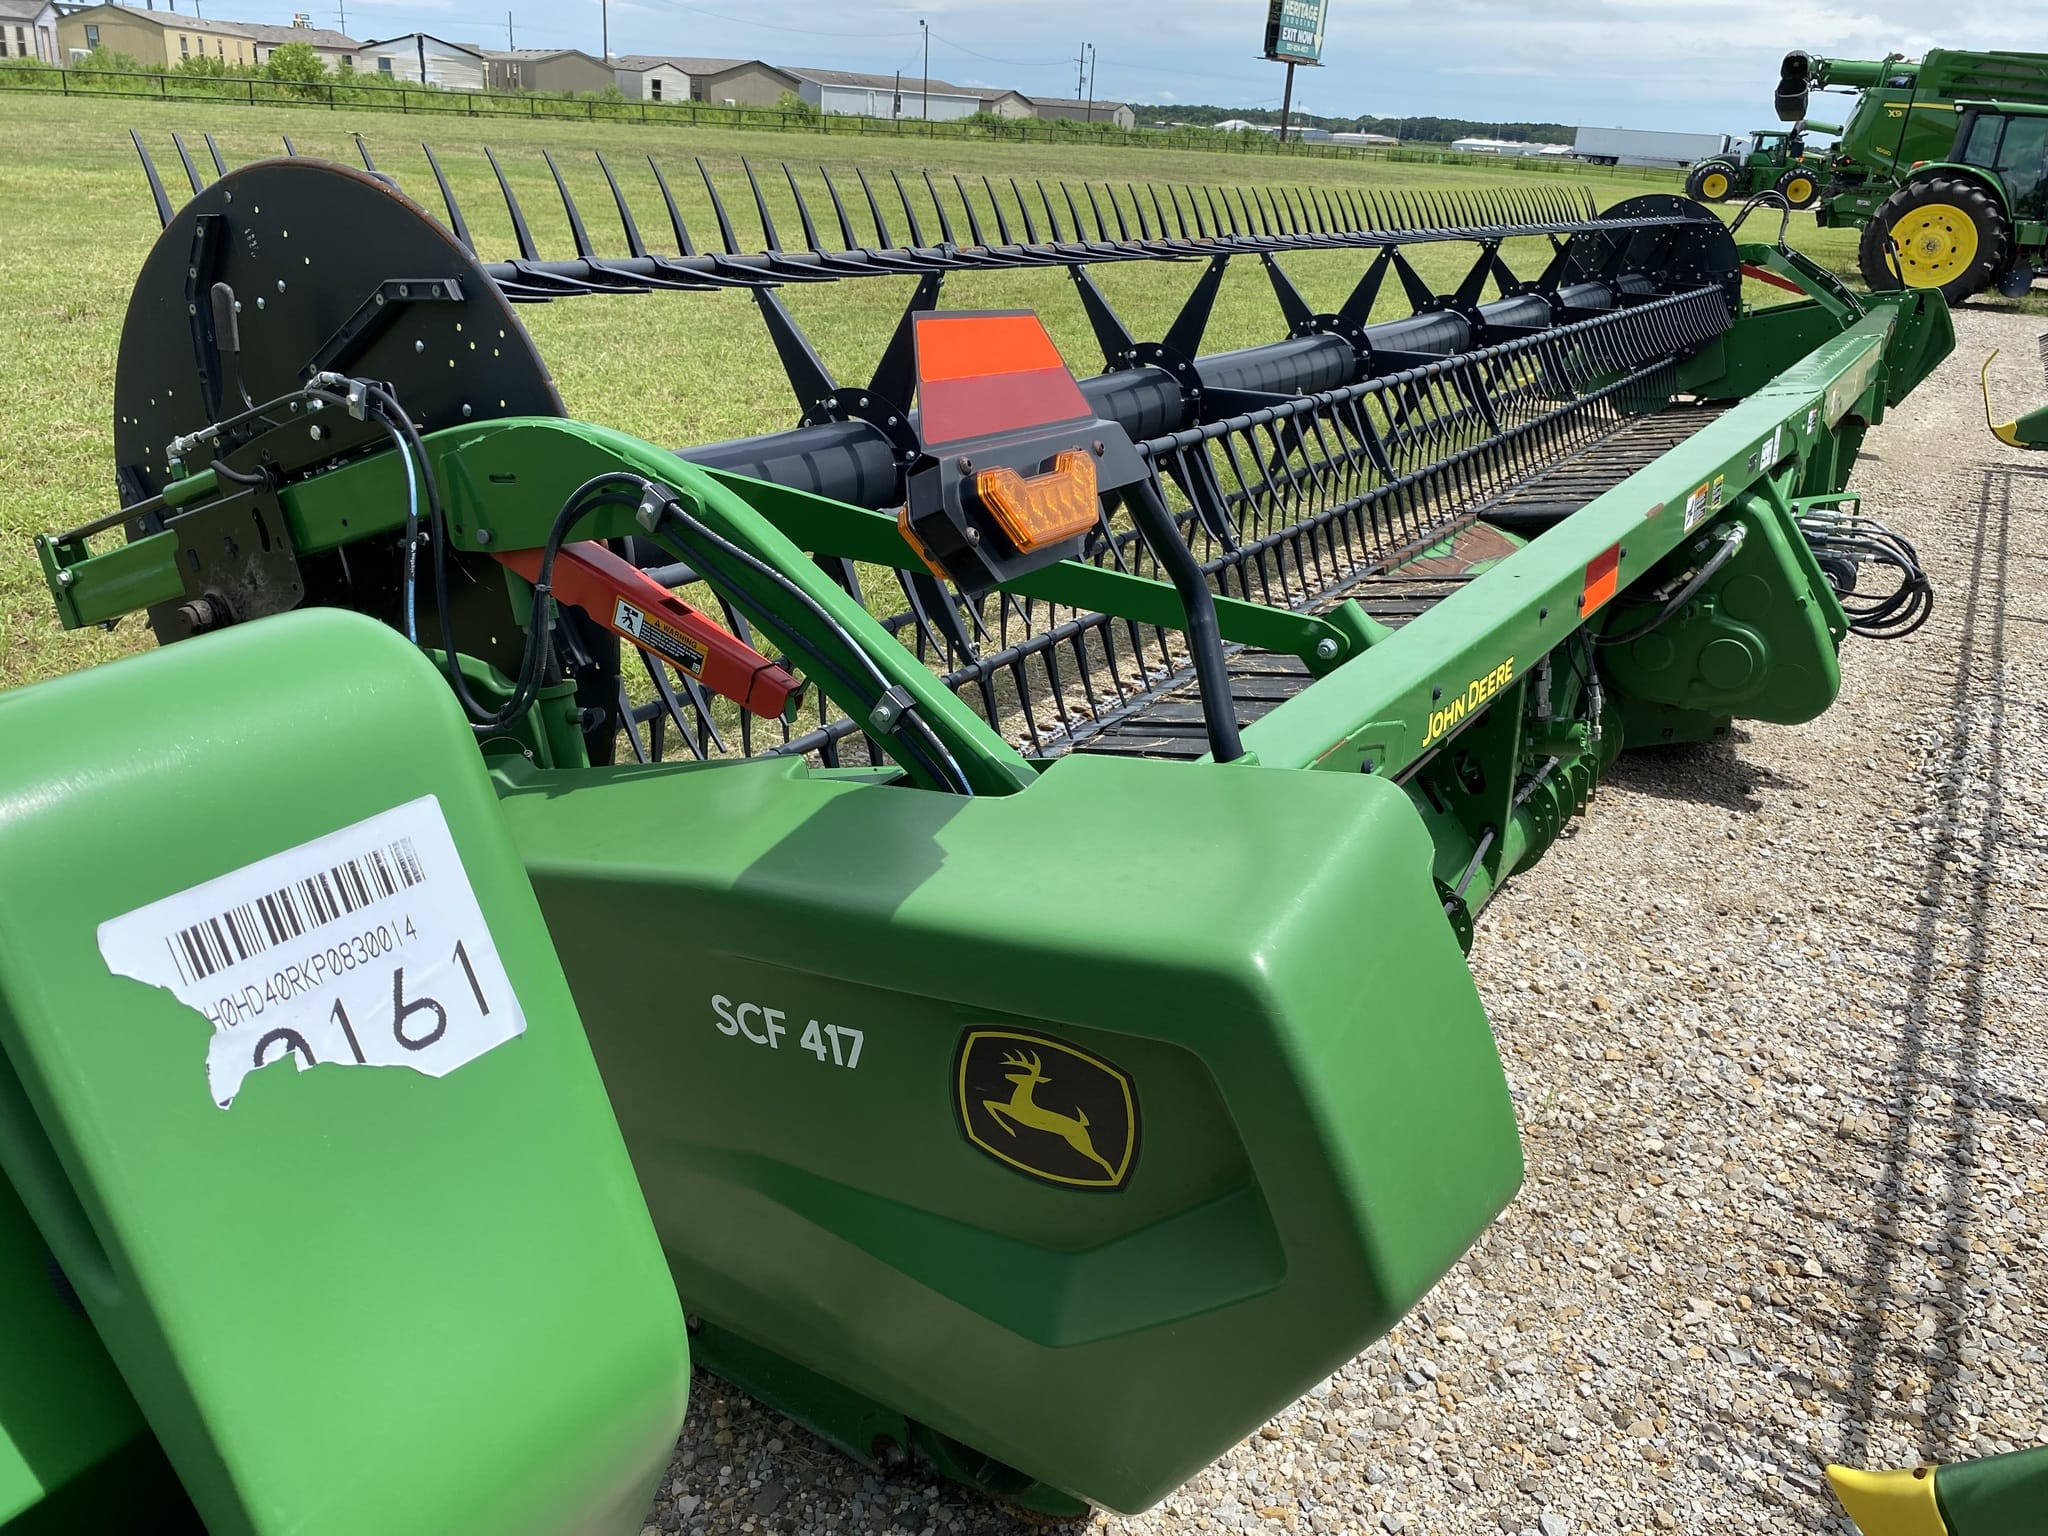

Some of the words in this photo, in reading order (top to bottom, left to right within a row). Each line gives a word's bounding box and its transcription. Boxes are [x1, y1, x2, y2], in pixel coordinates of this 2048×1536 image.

[1283, 0, 1318, 21] HERITAGE
[1282, 26, 1298, 43] EXIT
[1297, 29, 1314, 45] NOW
[1887, 109, 1903, 118] X9
[663, 623, 698, 649] WARNING
[1422, 693, 1466, 748] JOHN
[1467, 655, 1514, 713] DEERE
[711, 994, 786, 1049] SCF
[800, 1019, 865, 1069] 417
